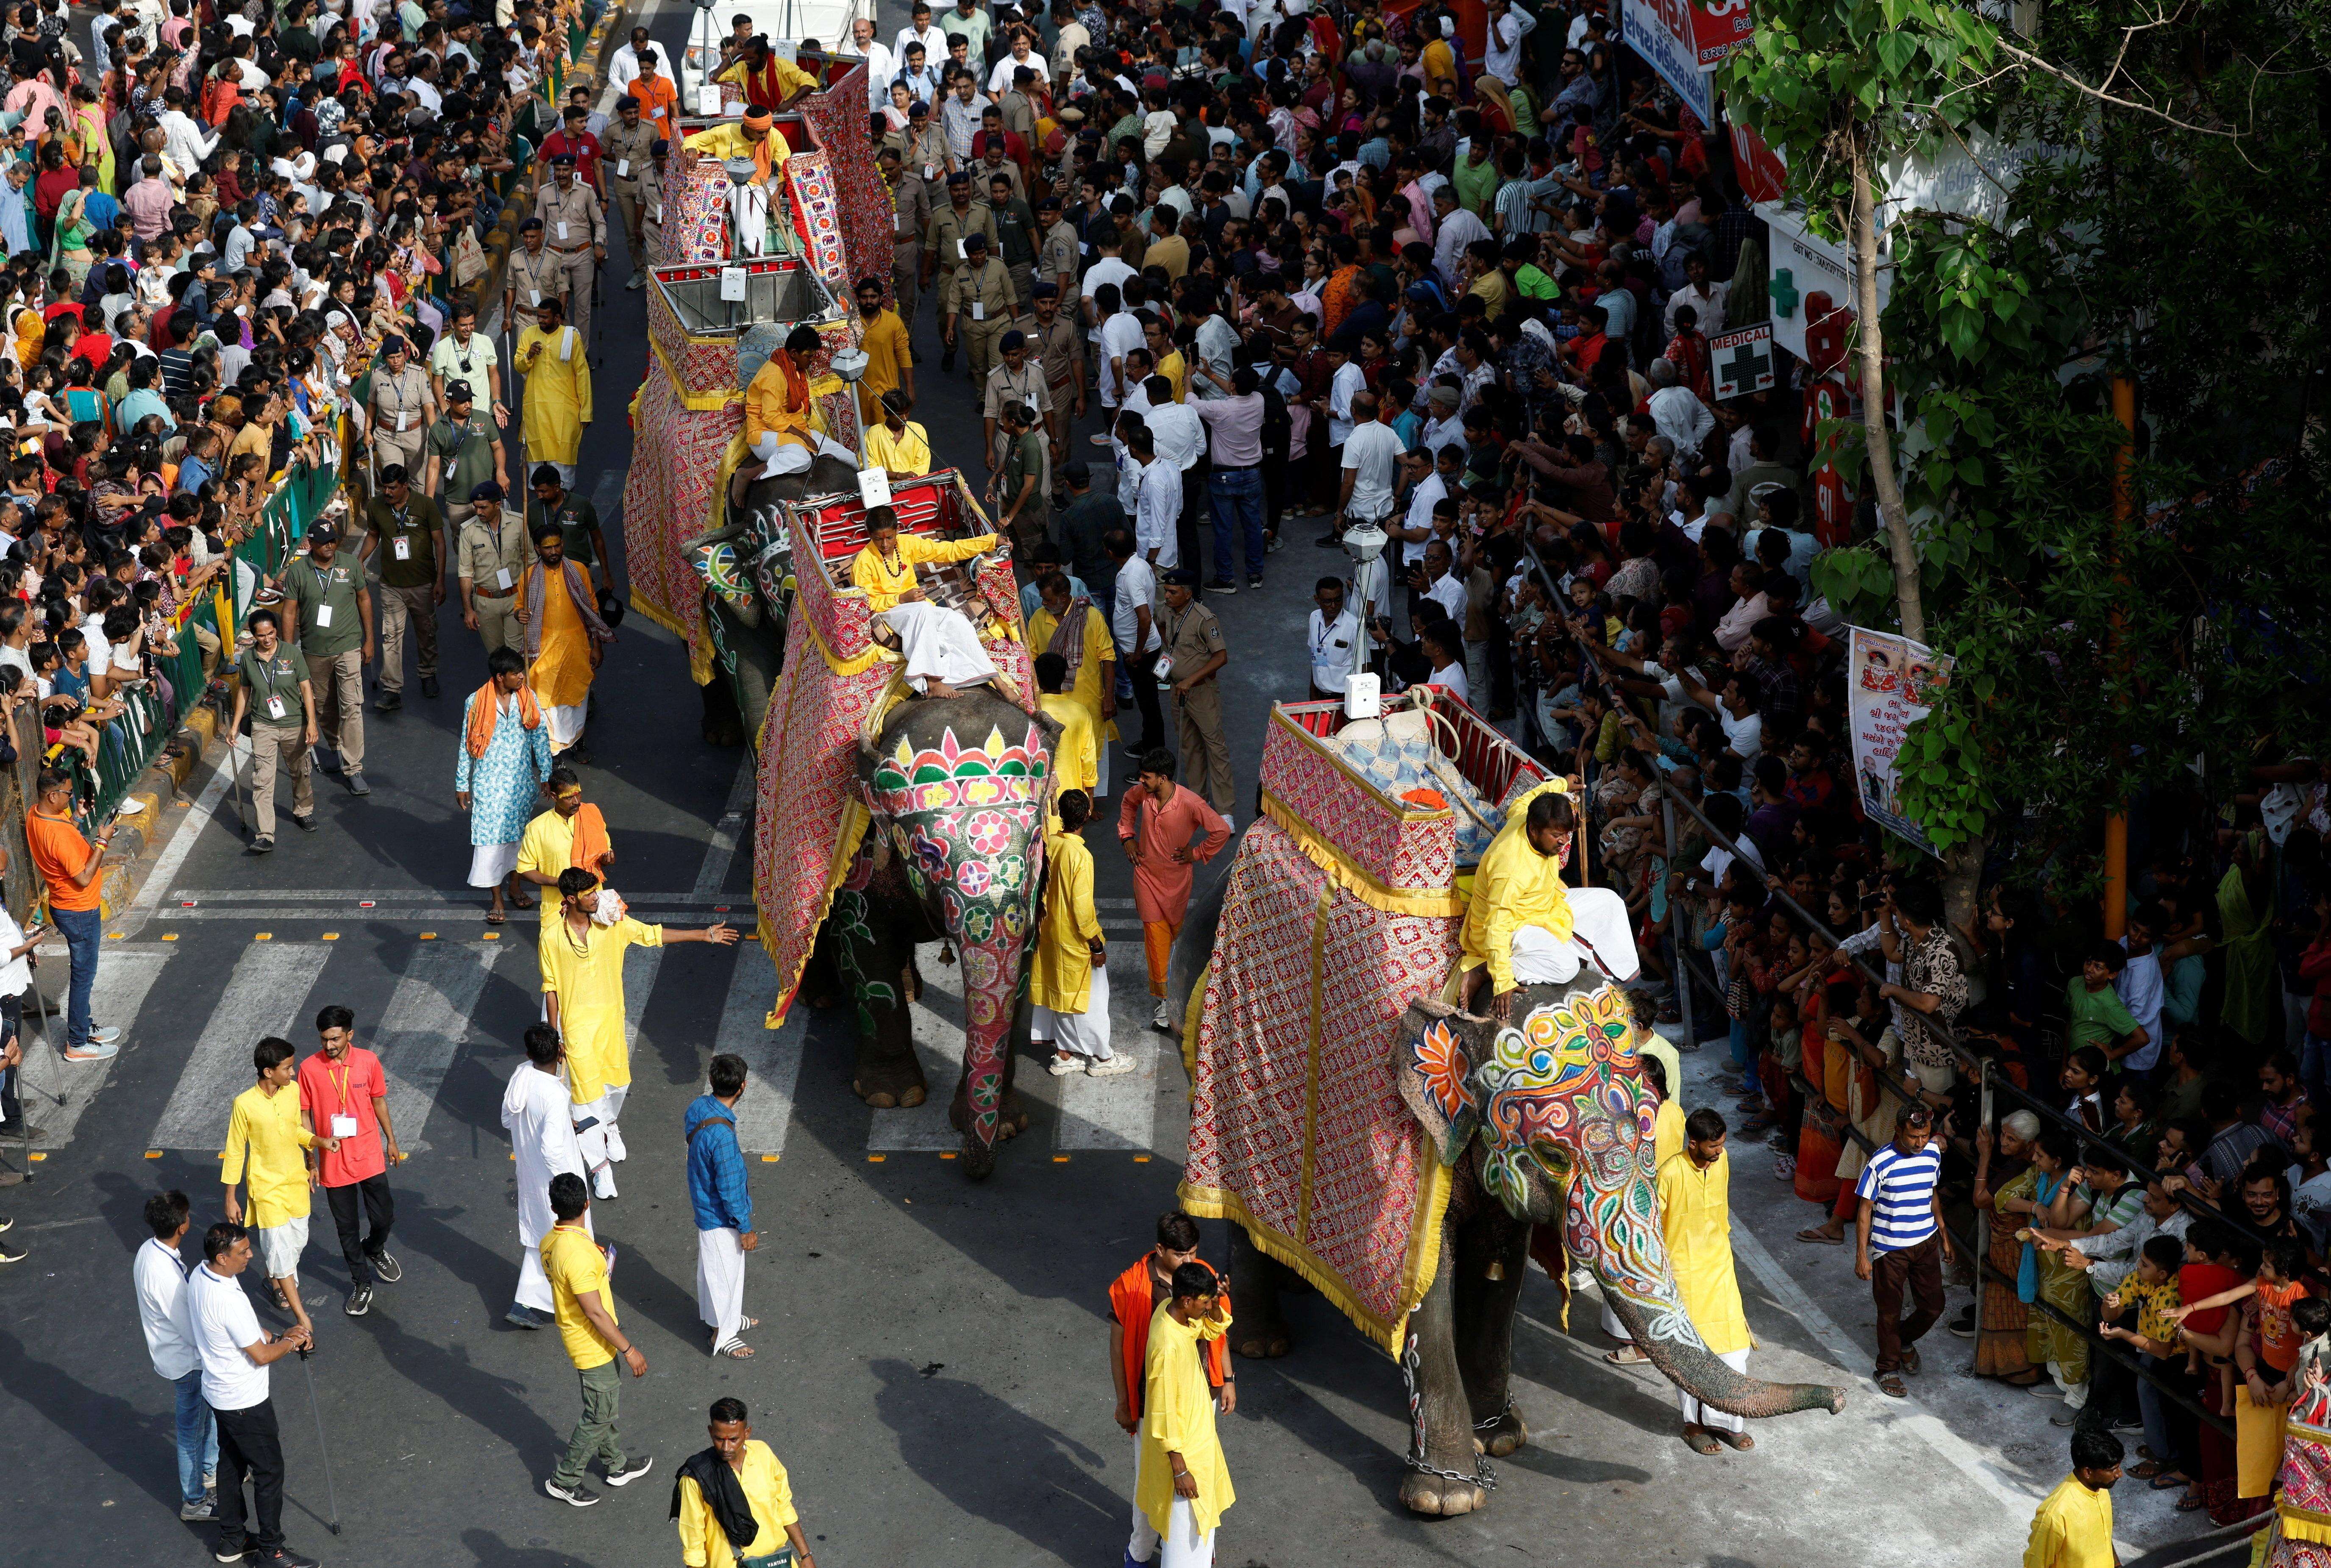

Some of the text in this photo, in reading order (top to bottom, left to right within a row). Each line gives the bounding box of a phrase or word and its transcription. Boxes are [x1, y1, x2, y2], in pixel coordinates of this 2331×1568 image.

[1632, 249, 1652, 261] STE
[1793, 242, 1804, 256] GST
[1805, 249, 1813, 261] NO
[1712, 328, 1769, 350] MEDICAL
[767, 1558, 787, 1568] VANTARA
